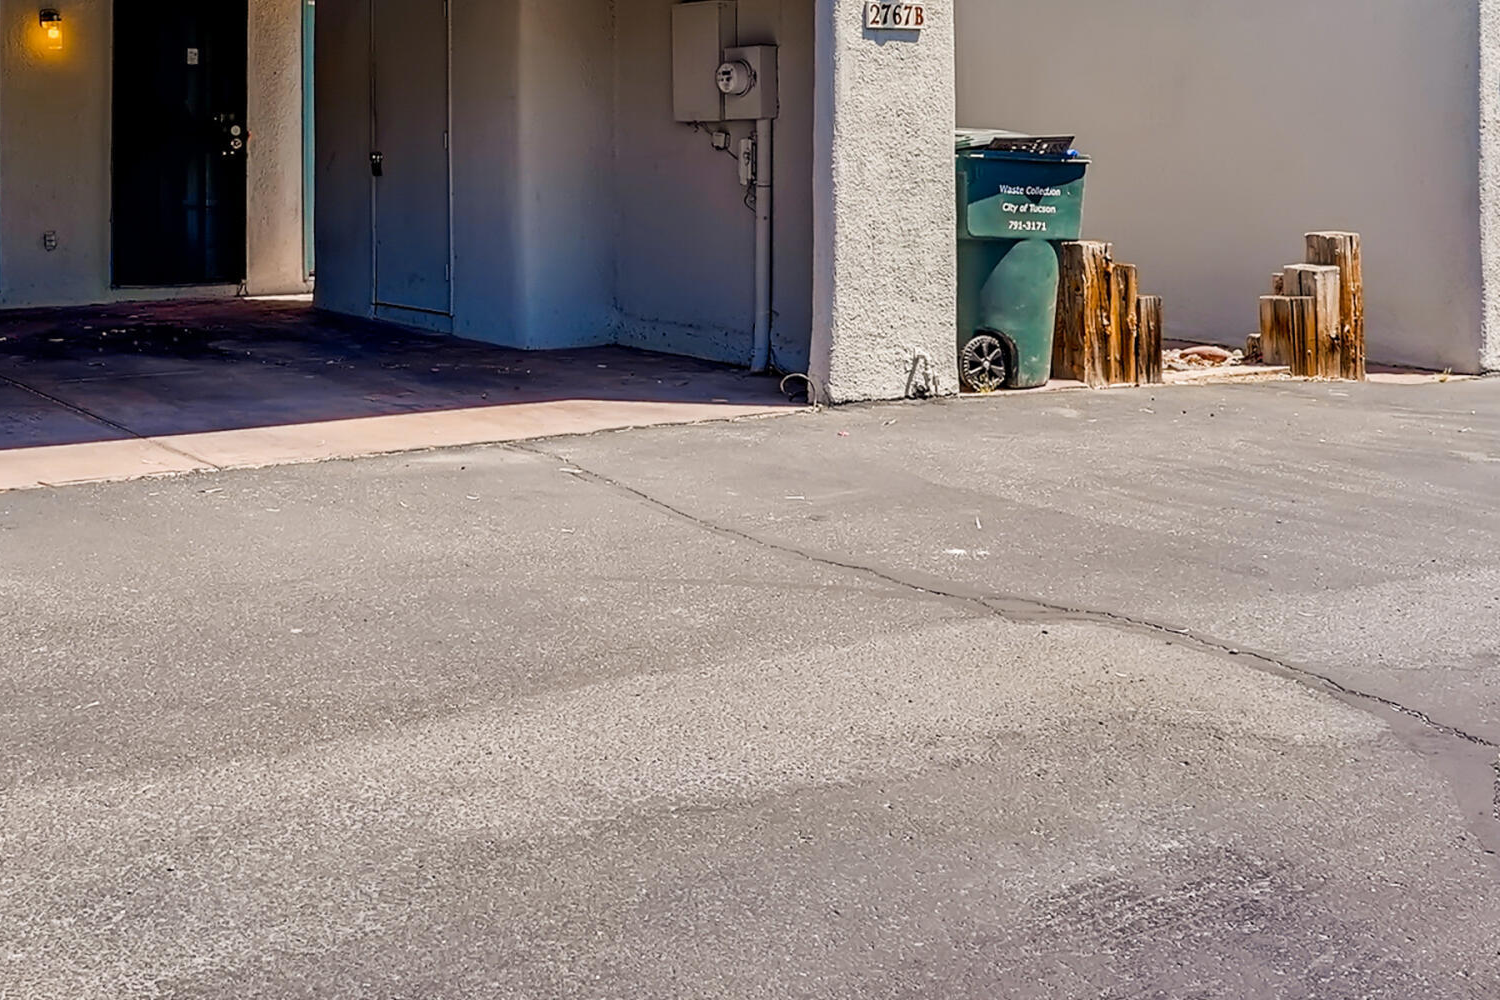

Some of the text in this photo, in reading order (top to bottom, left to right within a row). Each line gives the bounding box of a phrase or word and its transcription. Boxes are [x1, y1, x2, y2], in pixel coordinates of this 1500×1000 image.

[869, 4, 924, 26] 2767B
[999, 185, 1061, 196] Waste Collection
[1002, 202, 1056, 214] City of Tucson
[1008, 220, 1047, 231] 791-3171
